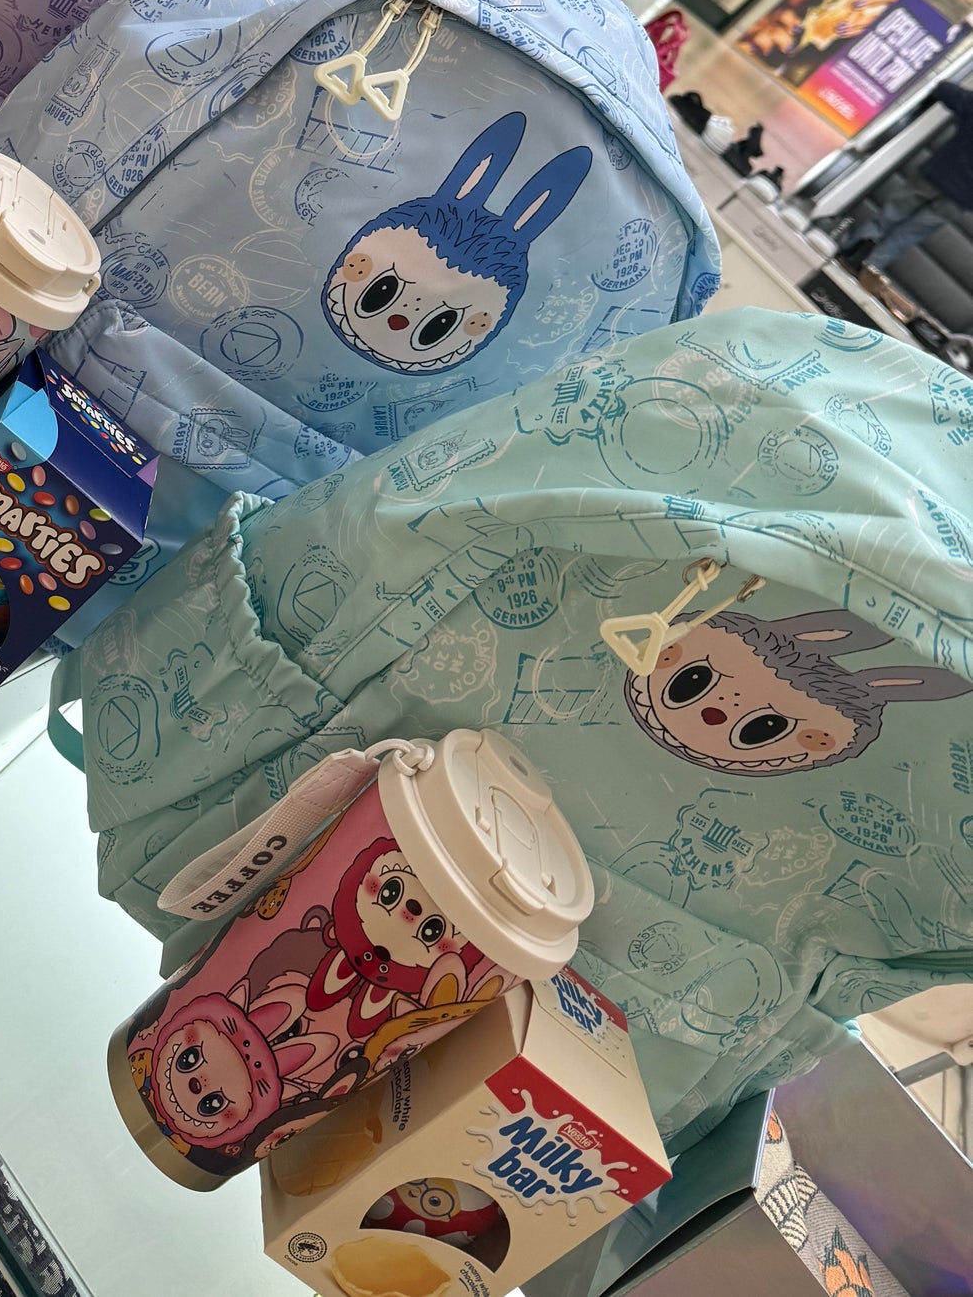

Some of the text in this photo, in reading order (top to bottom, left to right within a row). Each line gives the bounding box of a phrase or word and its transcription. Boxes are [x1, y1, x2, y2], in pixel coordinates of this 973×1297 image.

[292, 36, 351, 66] GERMANY
[308, 31, 337, 50] 1926
[121, 167, 144, 183] 1926
[628, 250, 644, 263] PM
[600, 265, 649, 290] GERMANY
[615, 264, 639, 279] 1926
[186, 270, 229, 309] BERN
[324, 389, 352, 403] 1926
[337, 380, 356, 392] PM
[307, 393, 362, 412] GERMANY
[517, 572, 539, 590] PM
[491, 597, 555, 626] GERMANY
[505, 589, 539, 611] 1926
[855, 824, 891, 844] 1926
[680, 835, 734, 879] ATHENS
[190, 835, 287, 913] COFFEE
[398, 1095, 411, 1132] white
[563, 1123, 594, 1149] Nestlé
[498, 1116, 604, 1194] Milky
[487, 1146, 556, 1199] bar
[464, 1260, 483, 1283] creamy
